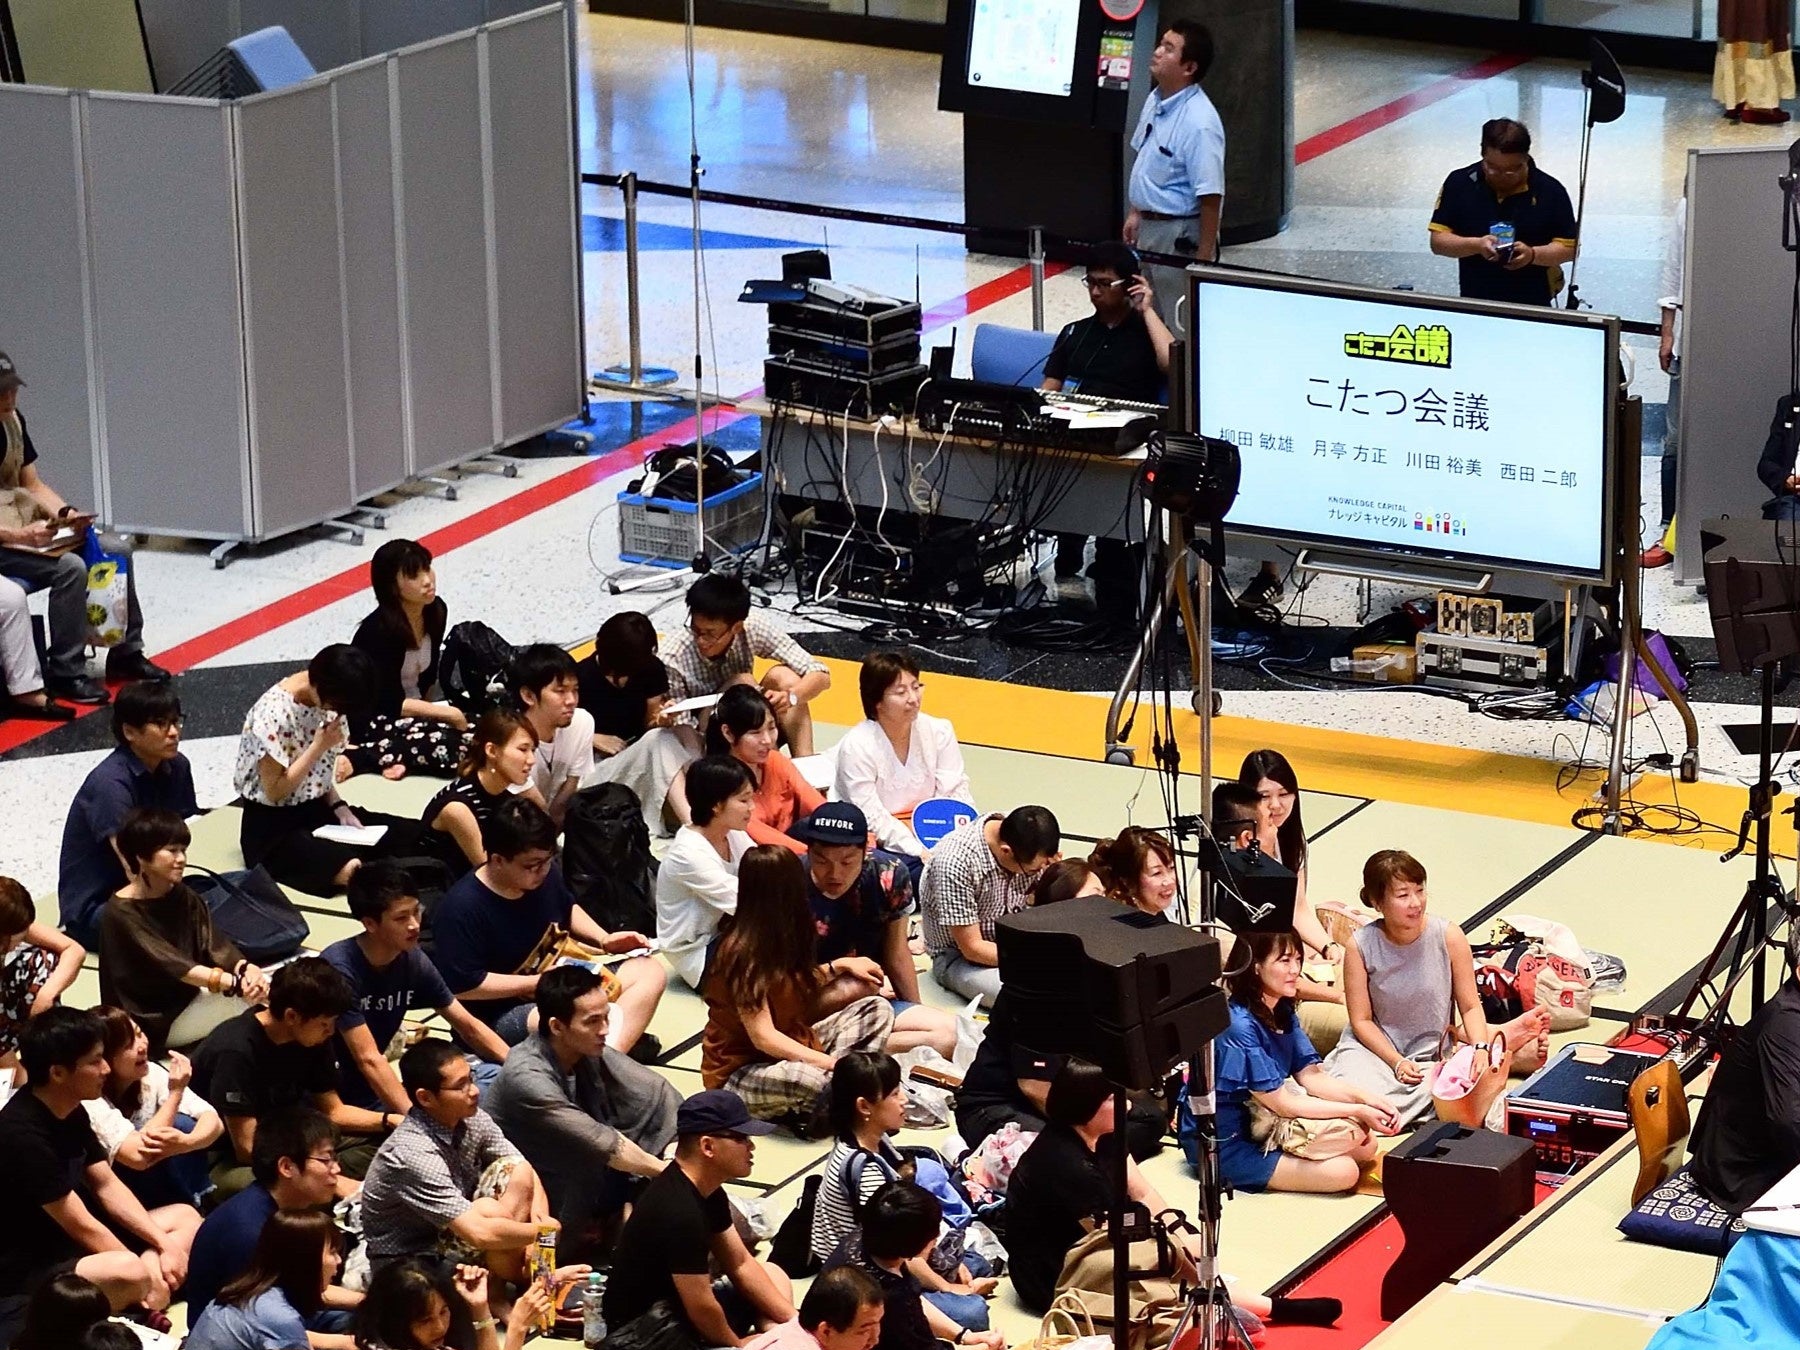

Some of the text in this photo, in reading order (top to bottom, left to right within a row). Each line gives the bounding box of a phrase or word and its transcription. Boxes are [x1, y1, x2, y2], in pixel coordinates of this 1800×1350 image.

[1344, 325, 1451, 366] こたつ会議
[1306, 378, 1490, 431] こたつ会議
[1259, 432, 1295, 453] 敏雄
[1313, 439, 1347, 459] 月亭
[1353, 444, 1388, 464] 方正
[1406, 451, 1440, 470] 川田
[1446, 455, 1482, 477] 裕美
[1500, 463, 1535, 482] 西田
[1541, 469, 1578, 488] 二郎
[1328, 496, 1407, 512] KNOWLEDGE CAPITAL
[815, 817, 854, 831] NEWYORK
